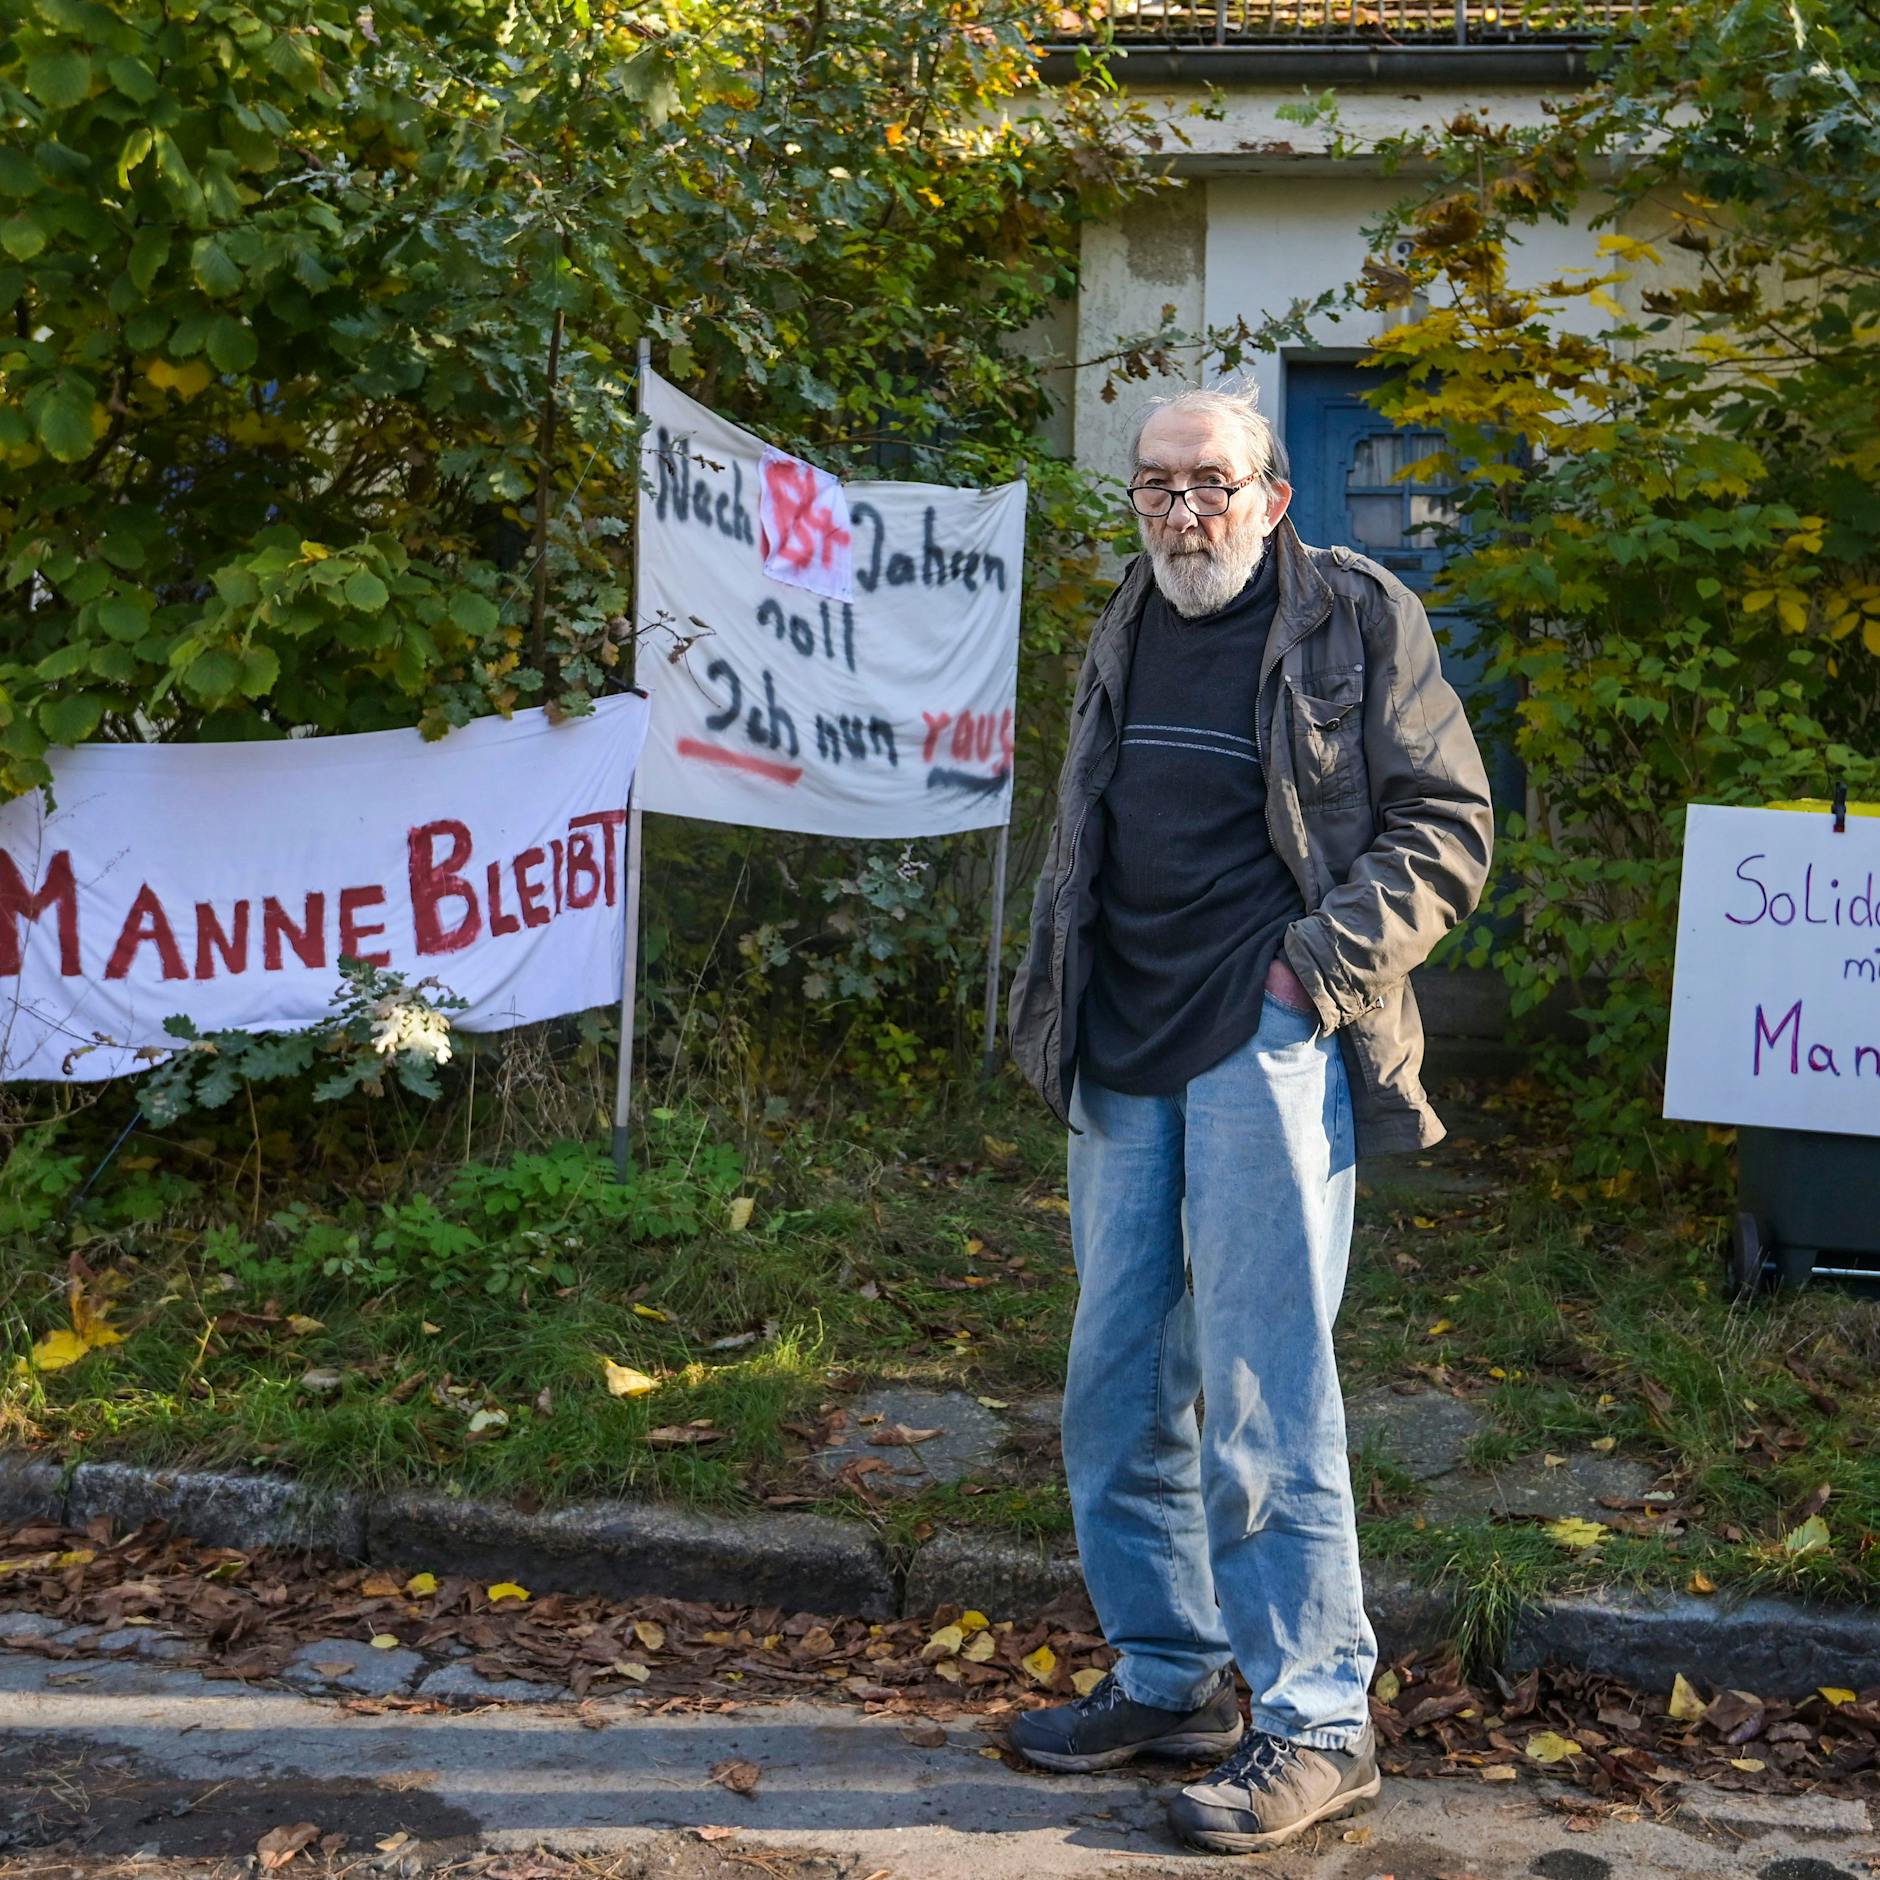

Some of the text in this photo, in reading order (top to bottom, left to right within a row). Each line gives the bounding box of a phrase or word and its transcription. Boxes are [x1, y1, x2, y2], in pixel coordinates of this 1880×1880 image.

[850, 502, 1005, 592] Jahren
[816, 713, 899, 767] nun
[921, 708, 1013, 777] raus
[0, 809, 628, 981] MANNE BLEIBT
